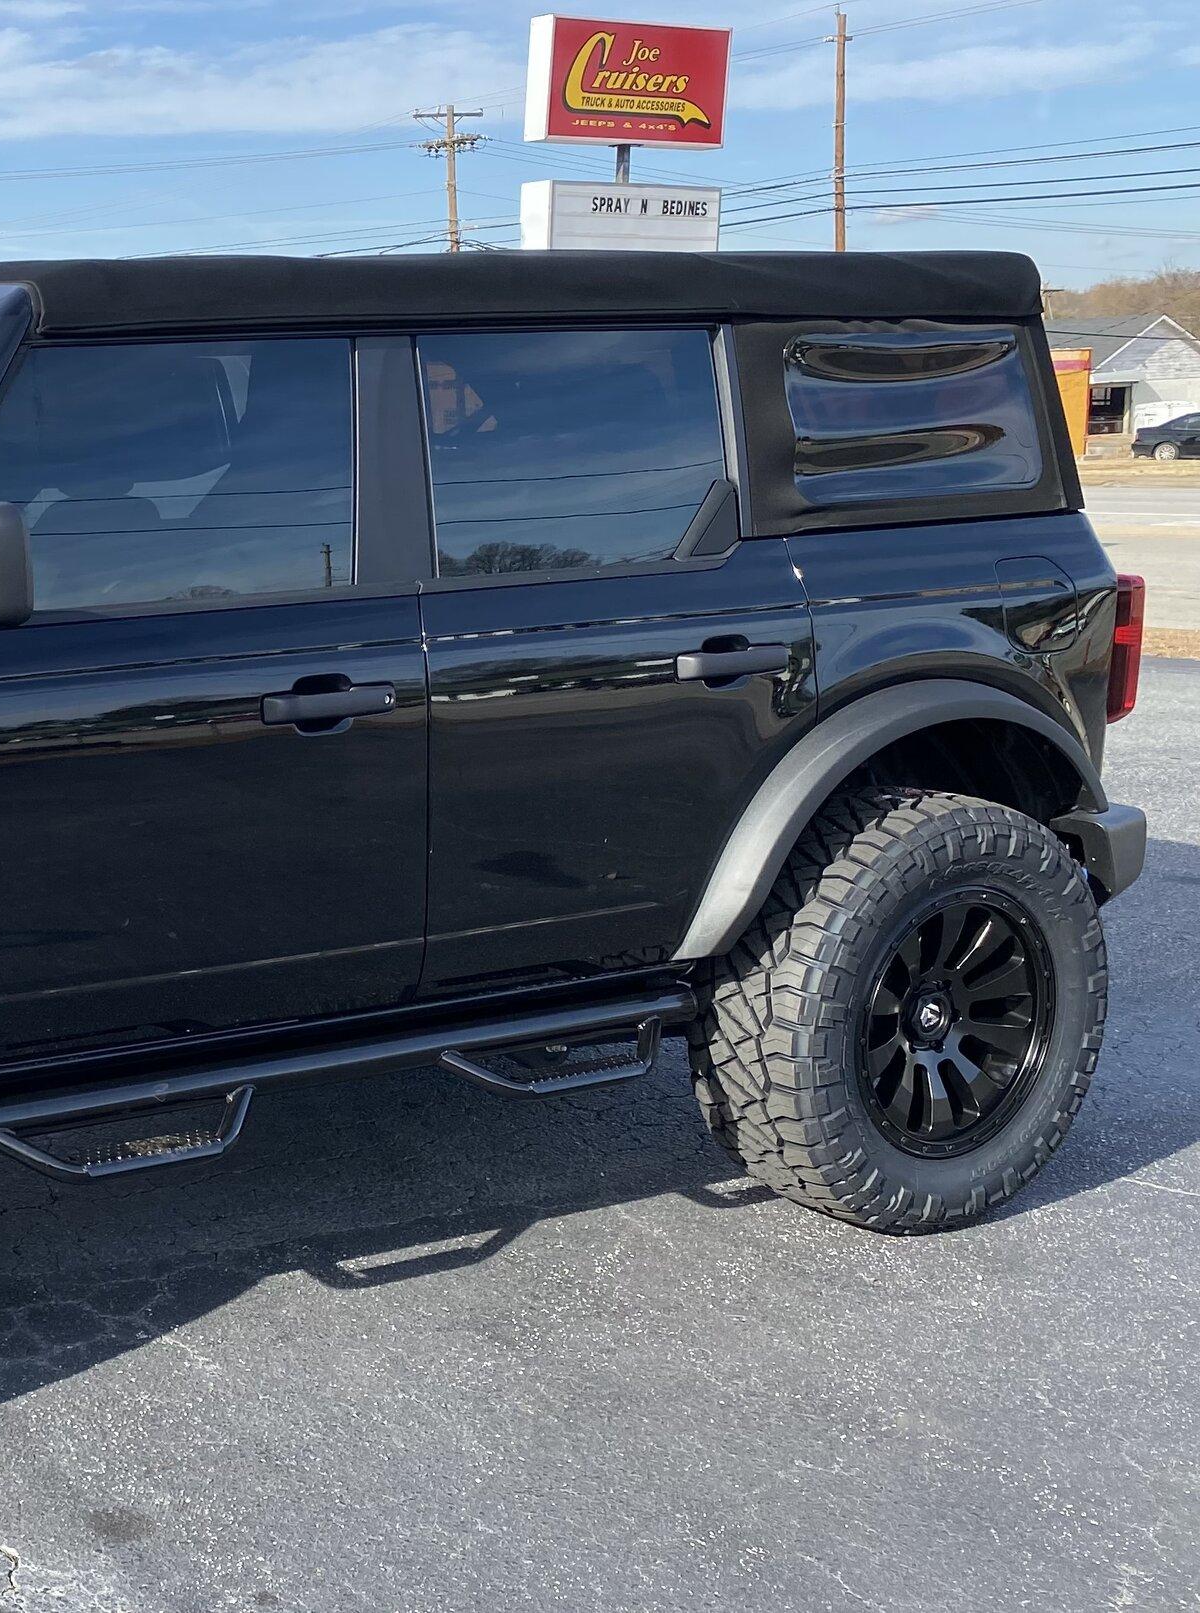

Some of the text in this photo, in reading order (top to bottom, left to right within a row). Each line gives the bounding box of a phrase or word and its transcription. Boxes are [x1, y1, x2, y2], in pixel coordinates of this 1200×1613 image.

[622, 40, 661, 66] Joe
[564, 31, 690, 108] Cruisers
[581, 96, 686, 113] TRUCK & AUTO ACCESSORIES
[571, 119, 616, 128] JEEPS
[622, 121, 633, 129] &
[591, 196, 708, 217] SPRAY N BEDINES
